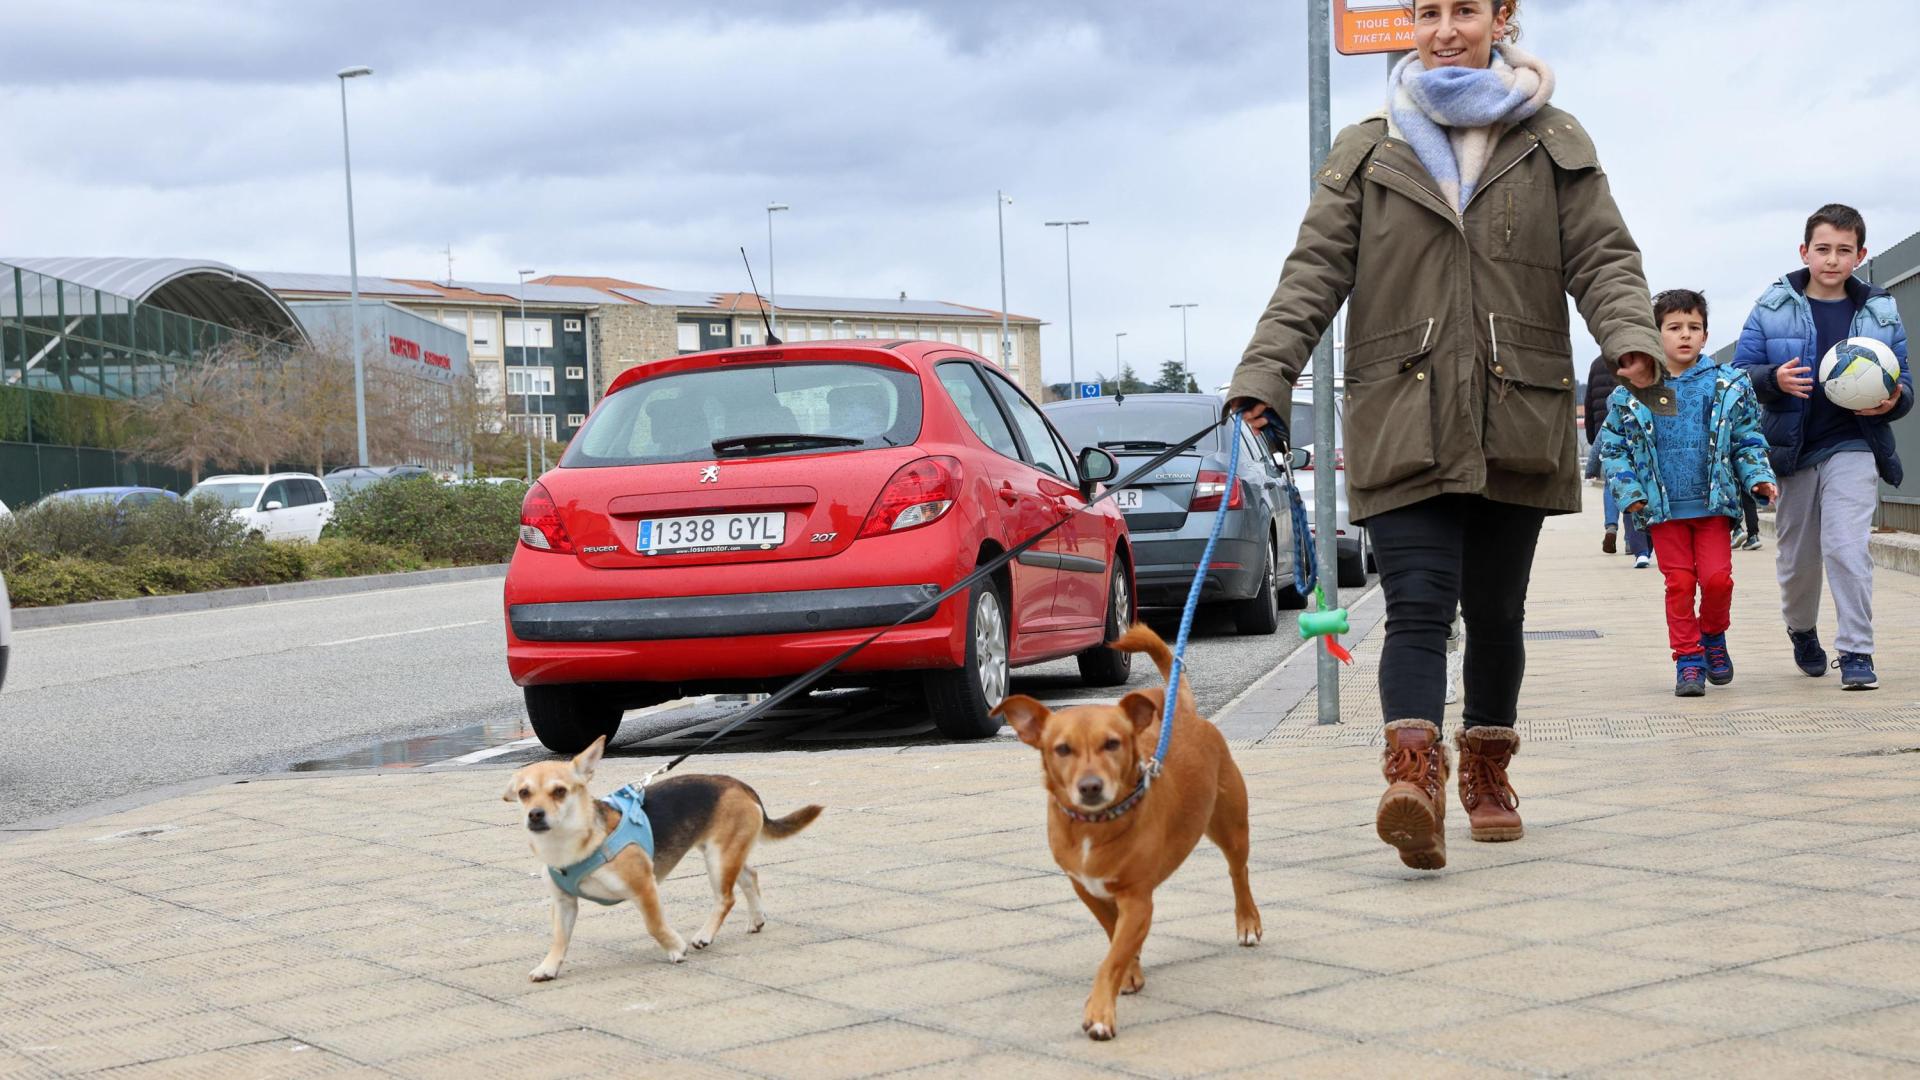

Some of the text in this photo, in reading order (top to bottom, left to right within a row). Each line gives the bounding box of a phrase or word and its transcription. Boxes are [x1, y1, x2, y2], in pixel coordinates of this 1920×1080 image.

[1356, 19, 1389, 29] TIQUE
[1353, 32, 1391, 43] TIKETA
[1155, 472, 1192, 480] OCTAVIA
[655, 516, 777, 545] 1338 GYL
[810, 532, 838, 543] 207
[583, 545, 619, 553] PEUGEOT
